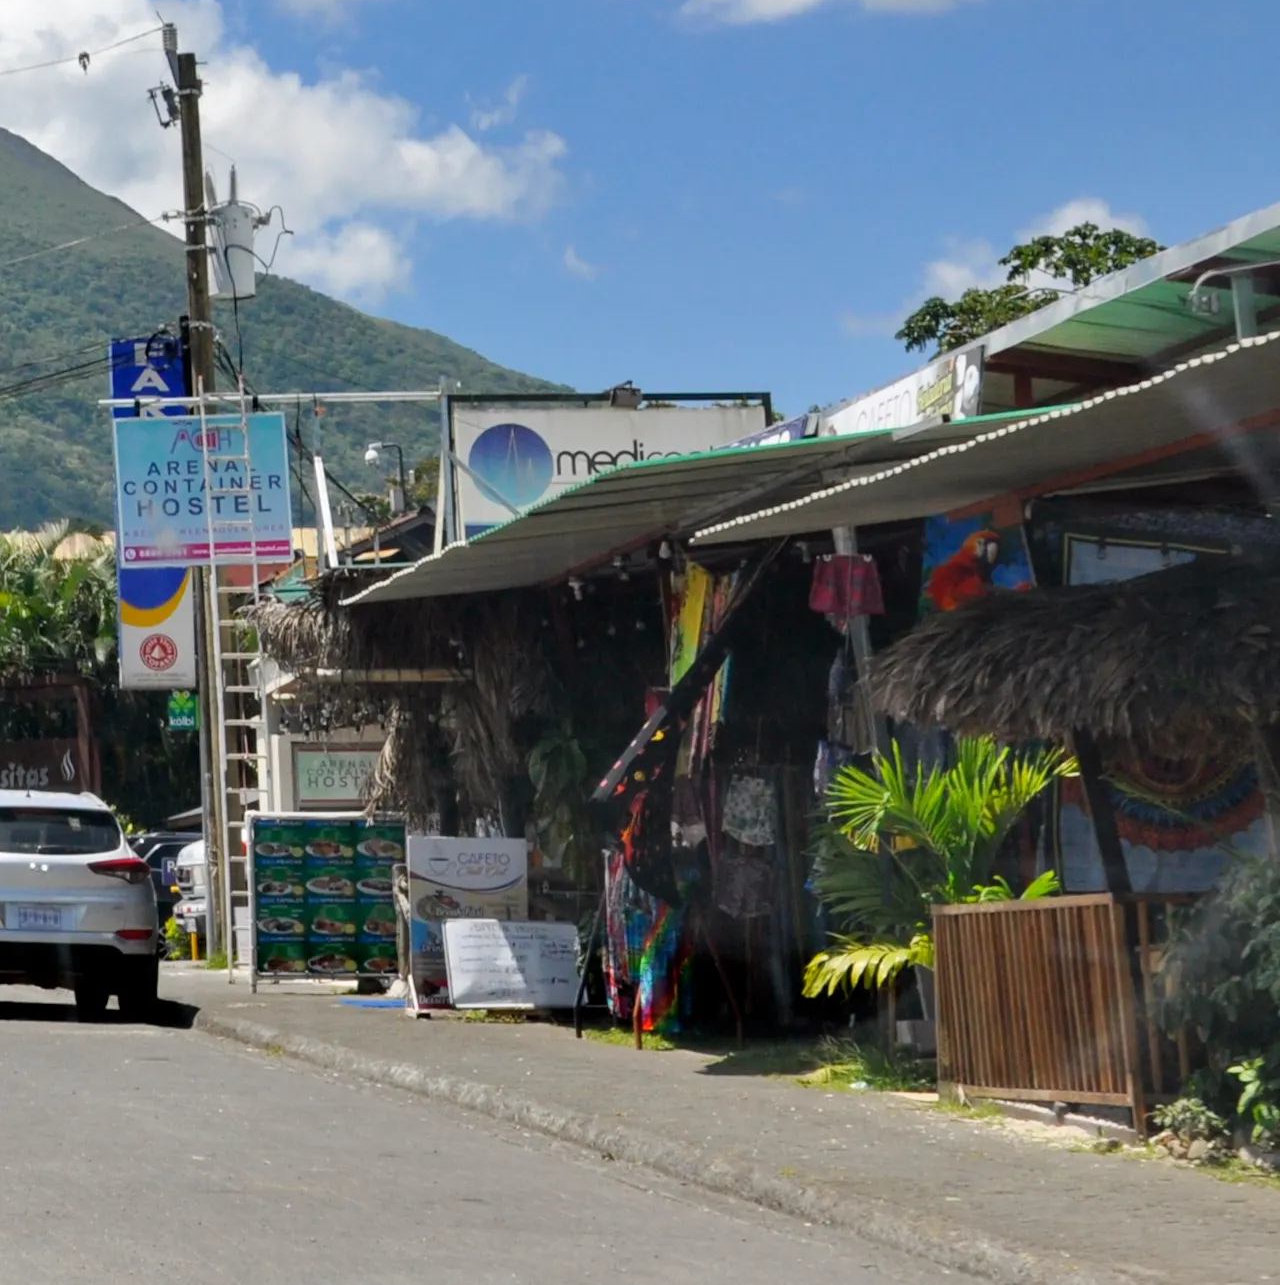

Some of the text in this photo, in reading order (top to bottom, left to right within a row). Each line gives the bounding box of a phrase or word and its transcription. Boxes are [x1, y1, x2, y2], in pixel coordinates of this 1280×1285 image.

[123, 475, 282, 496] CONTAINER
[137, 494, 272, 518] HOSTEL
[307, 768, 368, 777] CONTAIN
[308, 776, 362, 789] HOST
[457, 852, 511, 866] CAFETO
